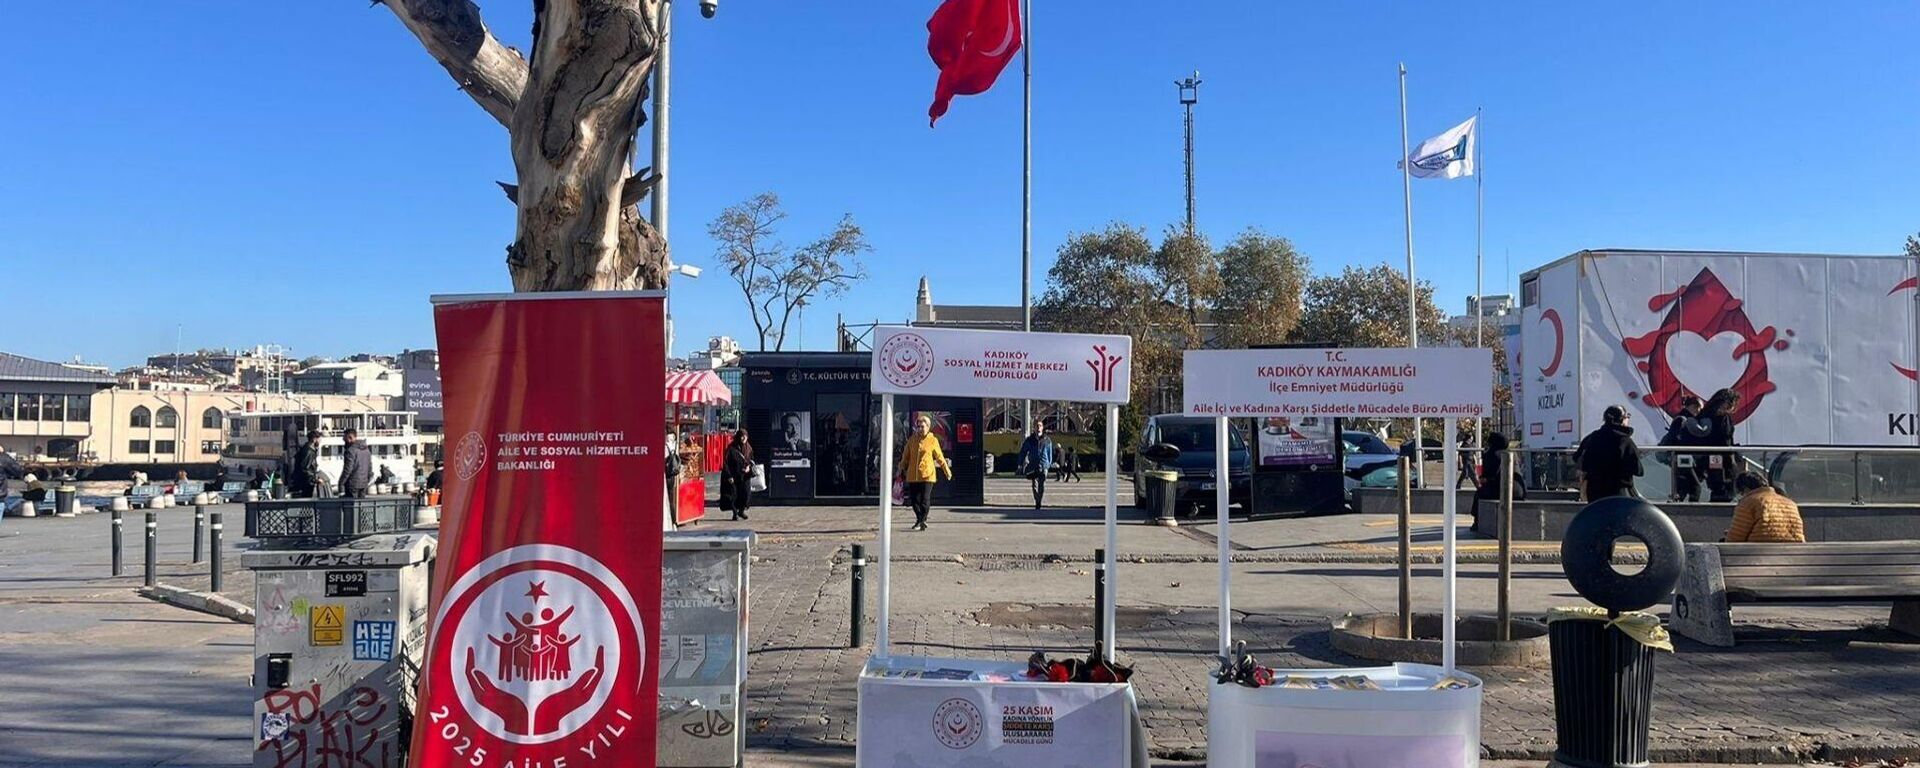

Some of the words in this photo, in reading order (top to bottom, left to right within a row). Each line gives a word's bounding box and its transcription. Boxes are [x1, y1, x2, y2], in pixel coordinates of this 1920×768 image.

[984, 350, 1028, 359] KADIKÖY
[1325, 352, 1347, 361] T.C.
[944, 359, 981, 368] SOSYAL
[1025, 361, 1068, 371] MERKEZİ
[1258, 364, 1313, 377] KADIKÖY
[1317, 364, 1416, 377] KAYMAKAMLIĞI
[819, 371, 848, 380] KÜLTÜR
[973, 369, 1038, 380] MÜDÜRLÜĞÜ
[1270, 381, 1288, 394] İlçe
[1291, 382, 1337, 393] Emniyet
[1340, 382, 1404, 394] Müdürlüğü
[1538, 393, 1565, 410] KIZILAY
[1193, 404, 1213, 413] Aile
[1215, 402, 1227, 415] İçi
[1243, 403, 1280, 413] Kadına
[1282, 404, 1309, 415] Karşı
[1311, 403, 1355, 415] Şiddetle
[1358, 404, 1410, 413] Mücadele
[1412, 404, 1438, 413] Büro
[1440, 403, 1483, 416] Amirliği
[498, 432, 544, 442] TÜRKİYE
[547, 431, 624, 441] CUMHURİYETİ
[498, 447, 520, 456] AİLE
[523, 447, 537, 455] VE
[540, 446, 583, 455] SOSYAL
[586, 445, 649, 455] HİZMETLER
[497, 461, 555, 470] BAKANLIĞI
[328, 573, 364, 583] SFL992
[356, 623, 392, 640] HEY
[1003, 706, 1016, 715] 25
[1018, 706, 1053, 716] KASIM
[430, 705, 487, 766] 2025
[580, 708, 632, 760] YILI
